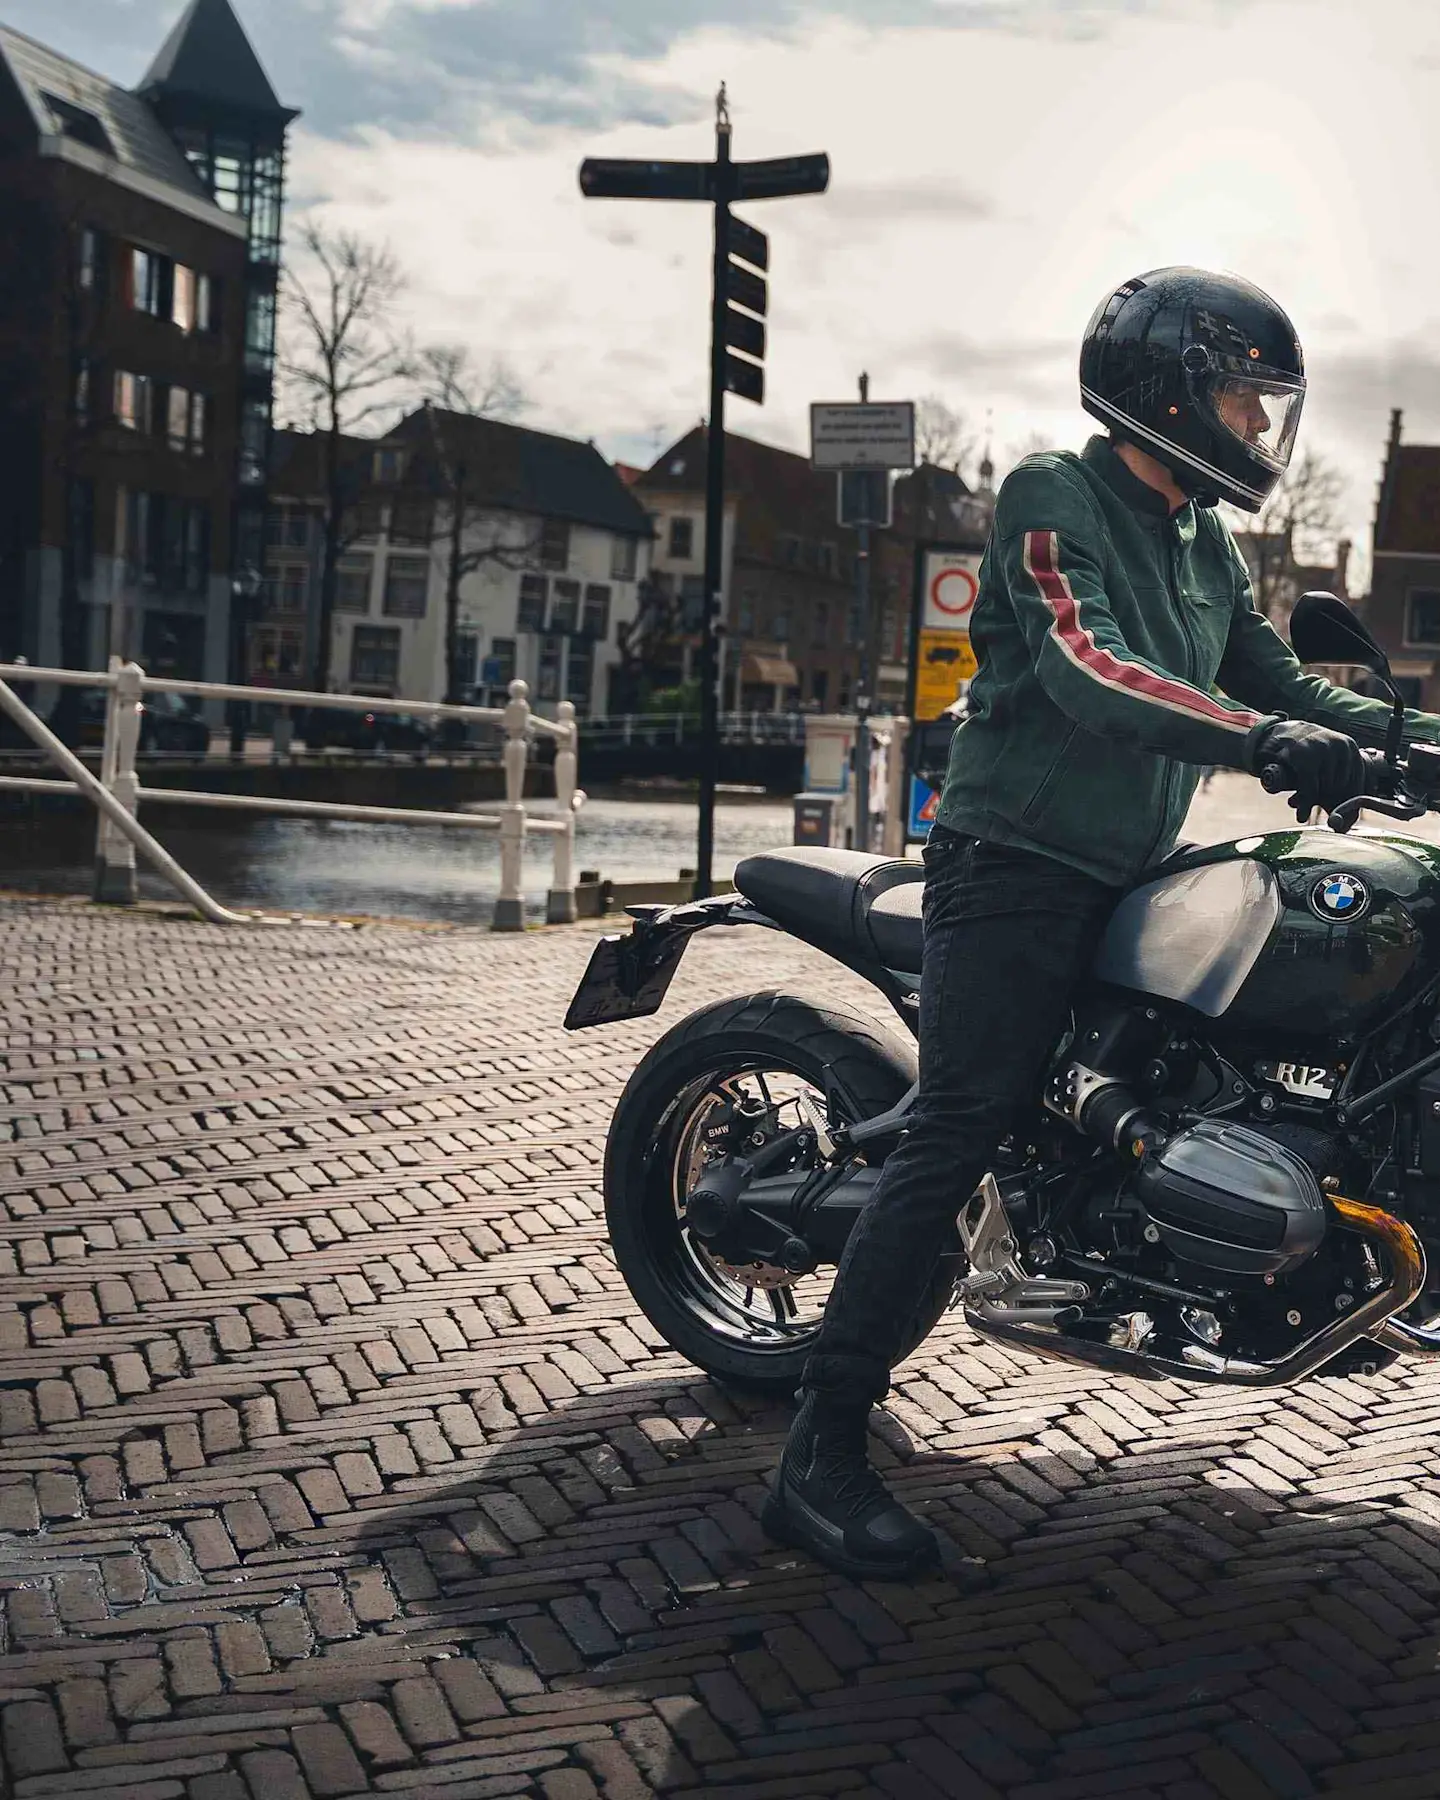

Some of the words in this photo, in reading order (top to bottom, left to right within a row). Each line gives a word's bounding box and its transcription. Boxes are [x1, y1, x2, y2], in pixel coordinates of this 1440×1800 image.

[1321, 875, 1363, 892] BMW
[1276, 1062, 1327, 1089] R12
[707, 1124, 729, 1138] BMW
